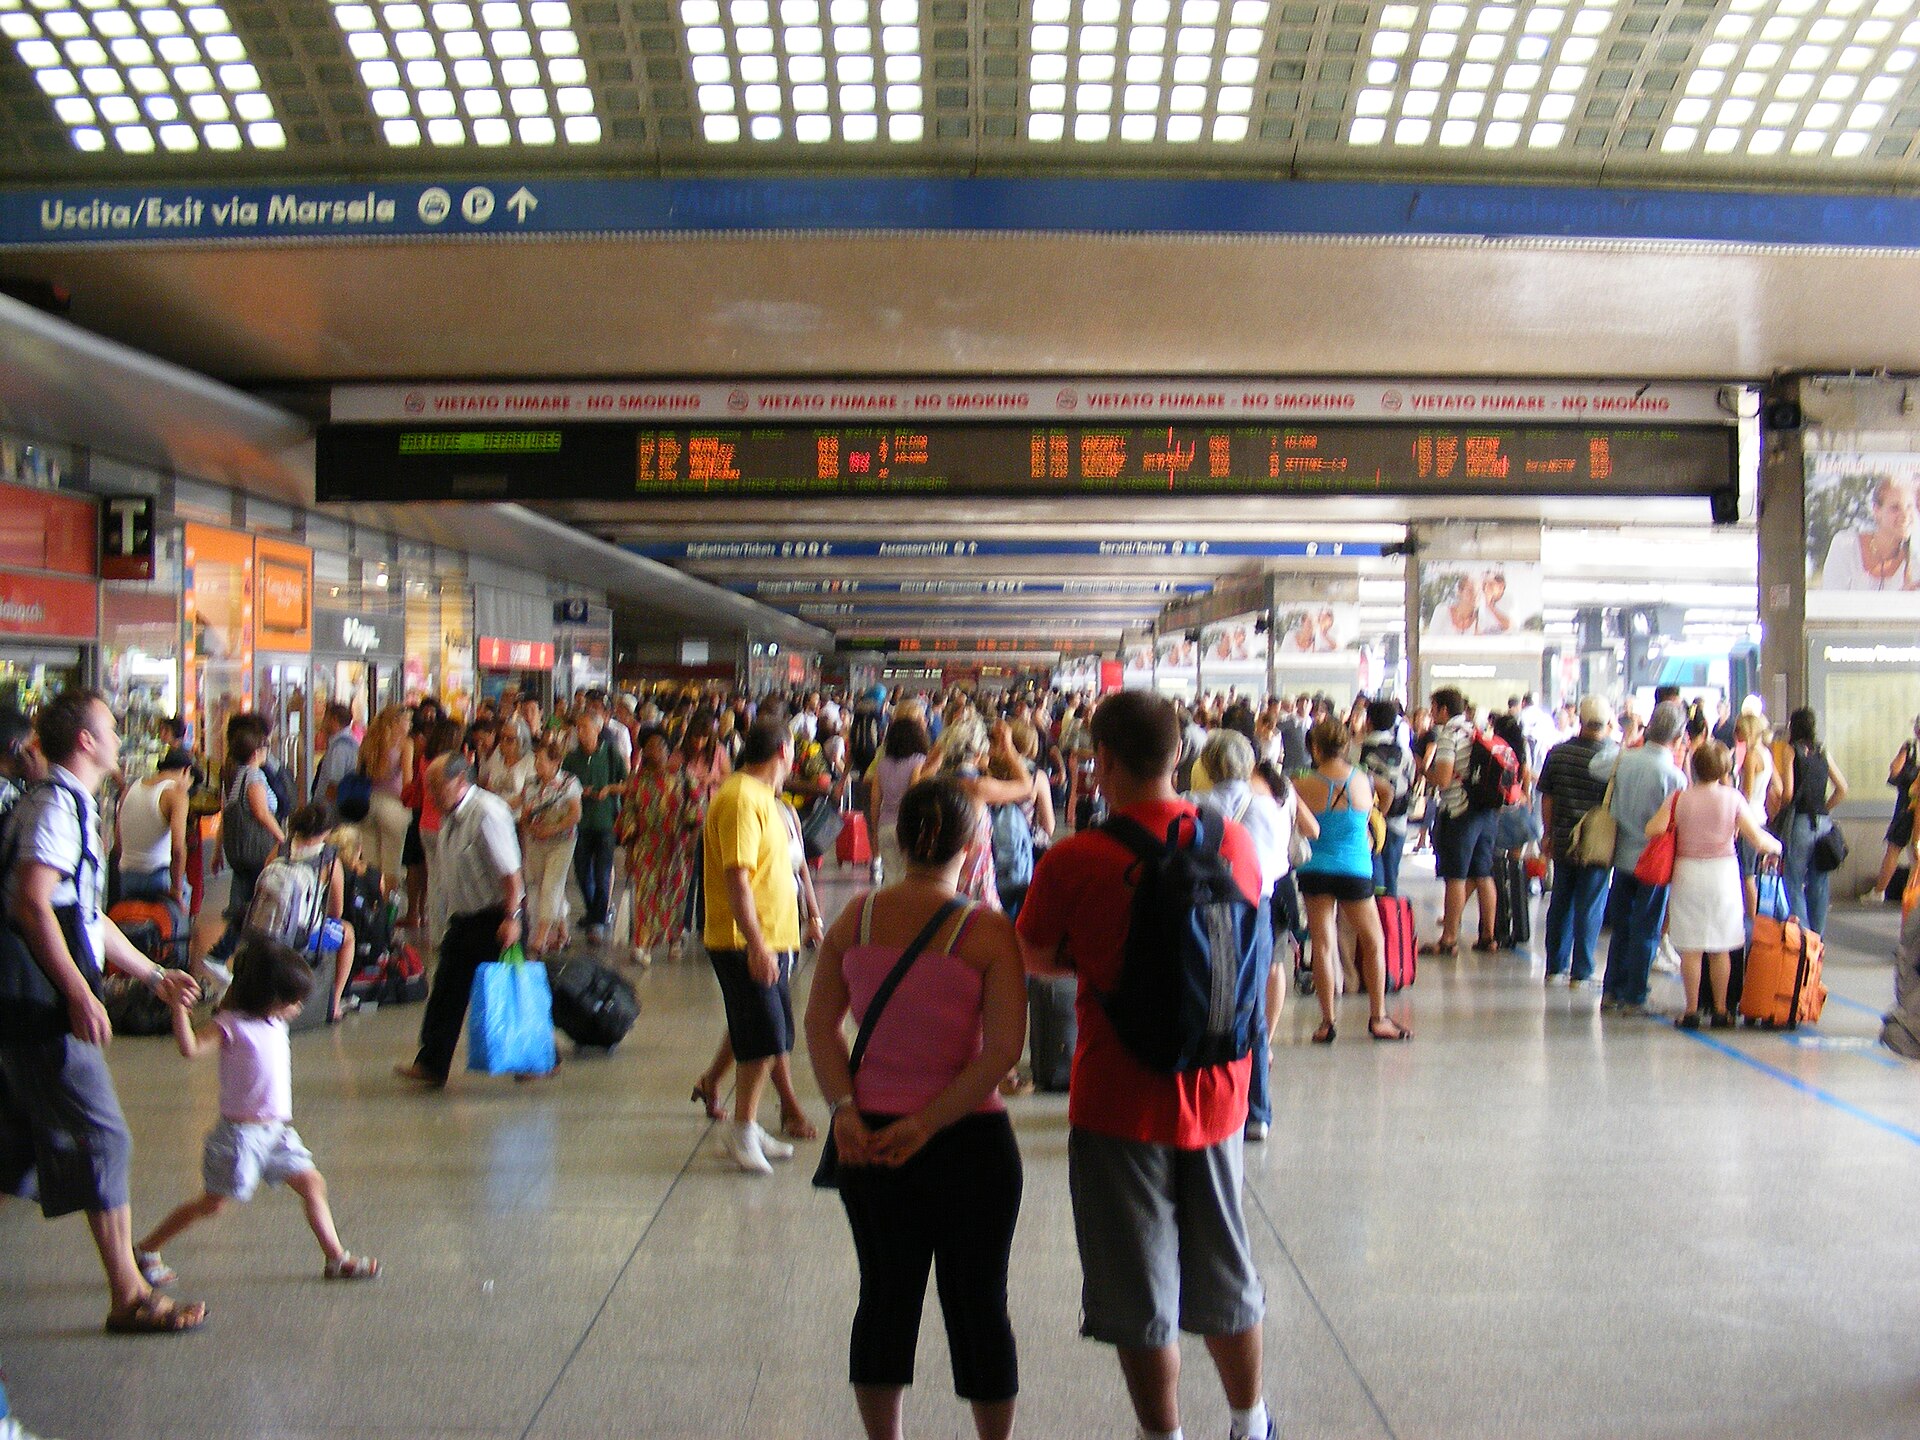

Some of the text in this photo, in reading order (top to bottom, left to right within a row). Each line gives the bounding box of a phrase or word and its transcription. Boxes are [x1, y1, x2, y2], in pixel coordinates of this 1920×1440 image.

[40, 198, 203, 230] Uscita/Exit
[212, 196, 258, 226] via
[266, 190, 396, 224] Marsala
[433, 395, 499, 411] VIETATO
[504, 395, 570, 411] FUMARE
[586, 395, 613, 410] NO
[618, 394, 700, 411] SMOKING
[757, 394, 824, 411] VIETATO
[829, 394, 897, 410] FUMARE
[914, 394, 941, 410] NO
[946, 393, 1028, 410] SMOKING
[1086, 393, 1153, 410] VIETATO
[1158, 393, 1225, 410] FUMARE
[1241, 393, 1268, 410] NO
[1273, 393, 1355, 410] SMOKING
[1410, 394, 1476, 411] VIETATO
[1480, 394, 1545, 411] FUMARE
[1561, 395, 1587, 411] NO
[1592, 395, 1670, 412] SMOKING
